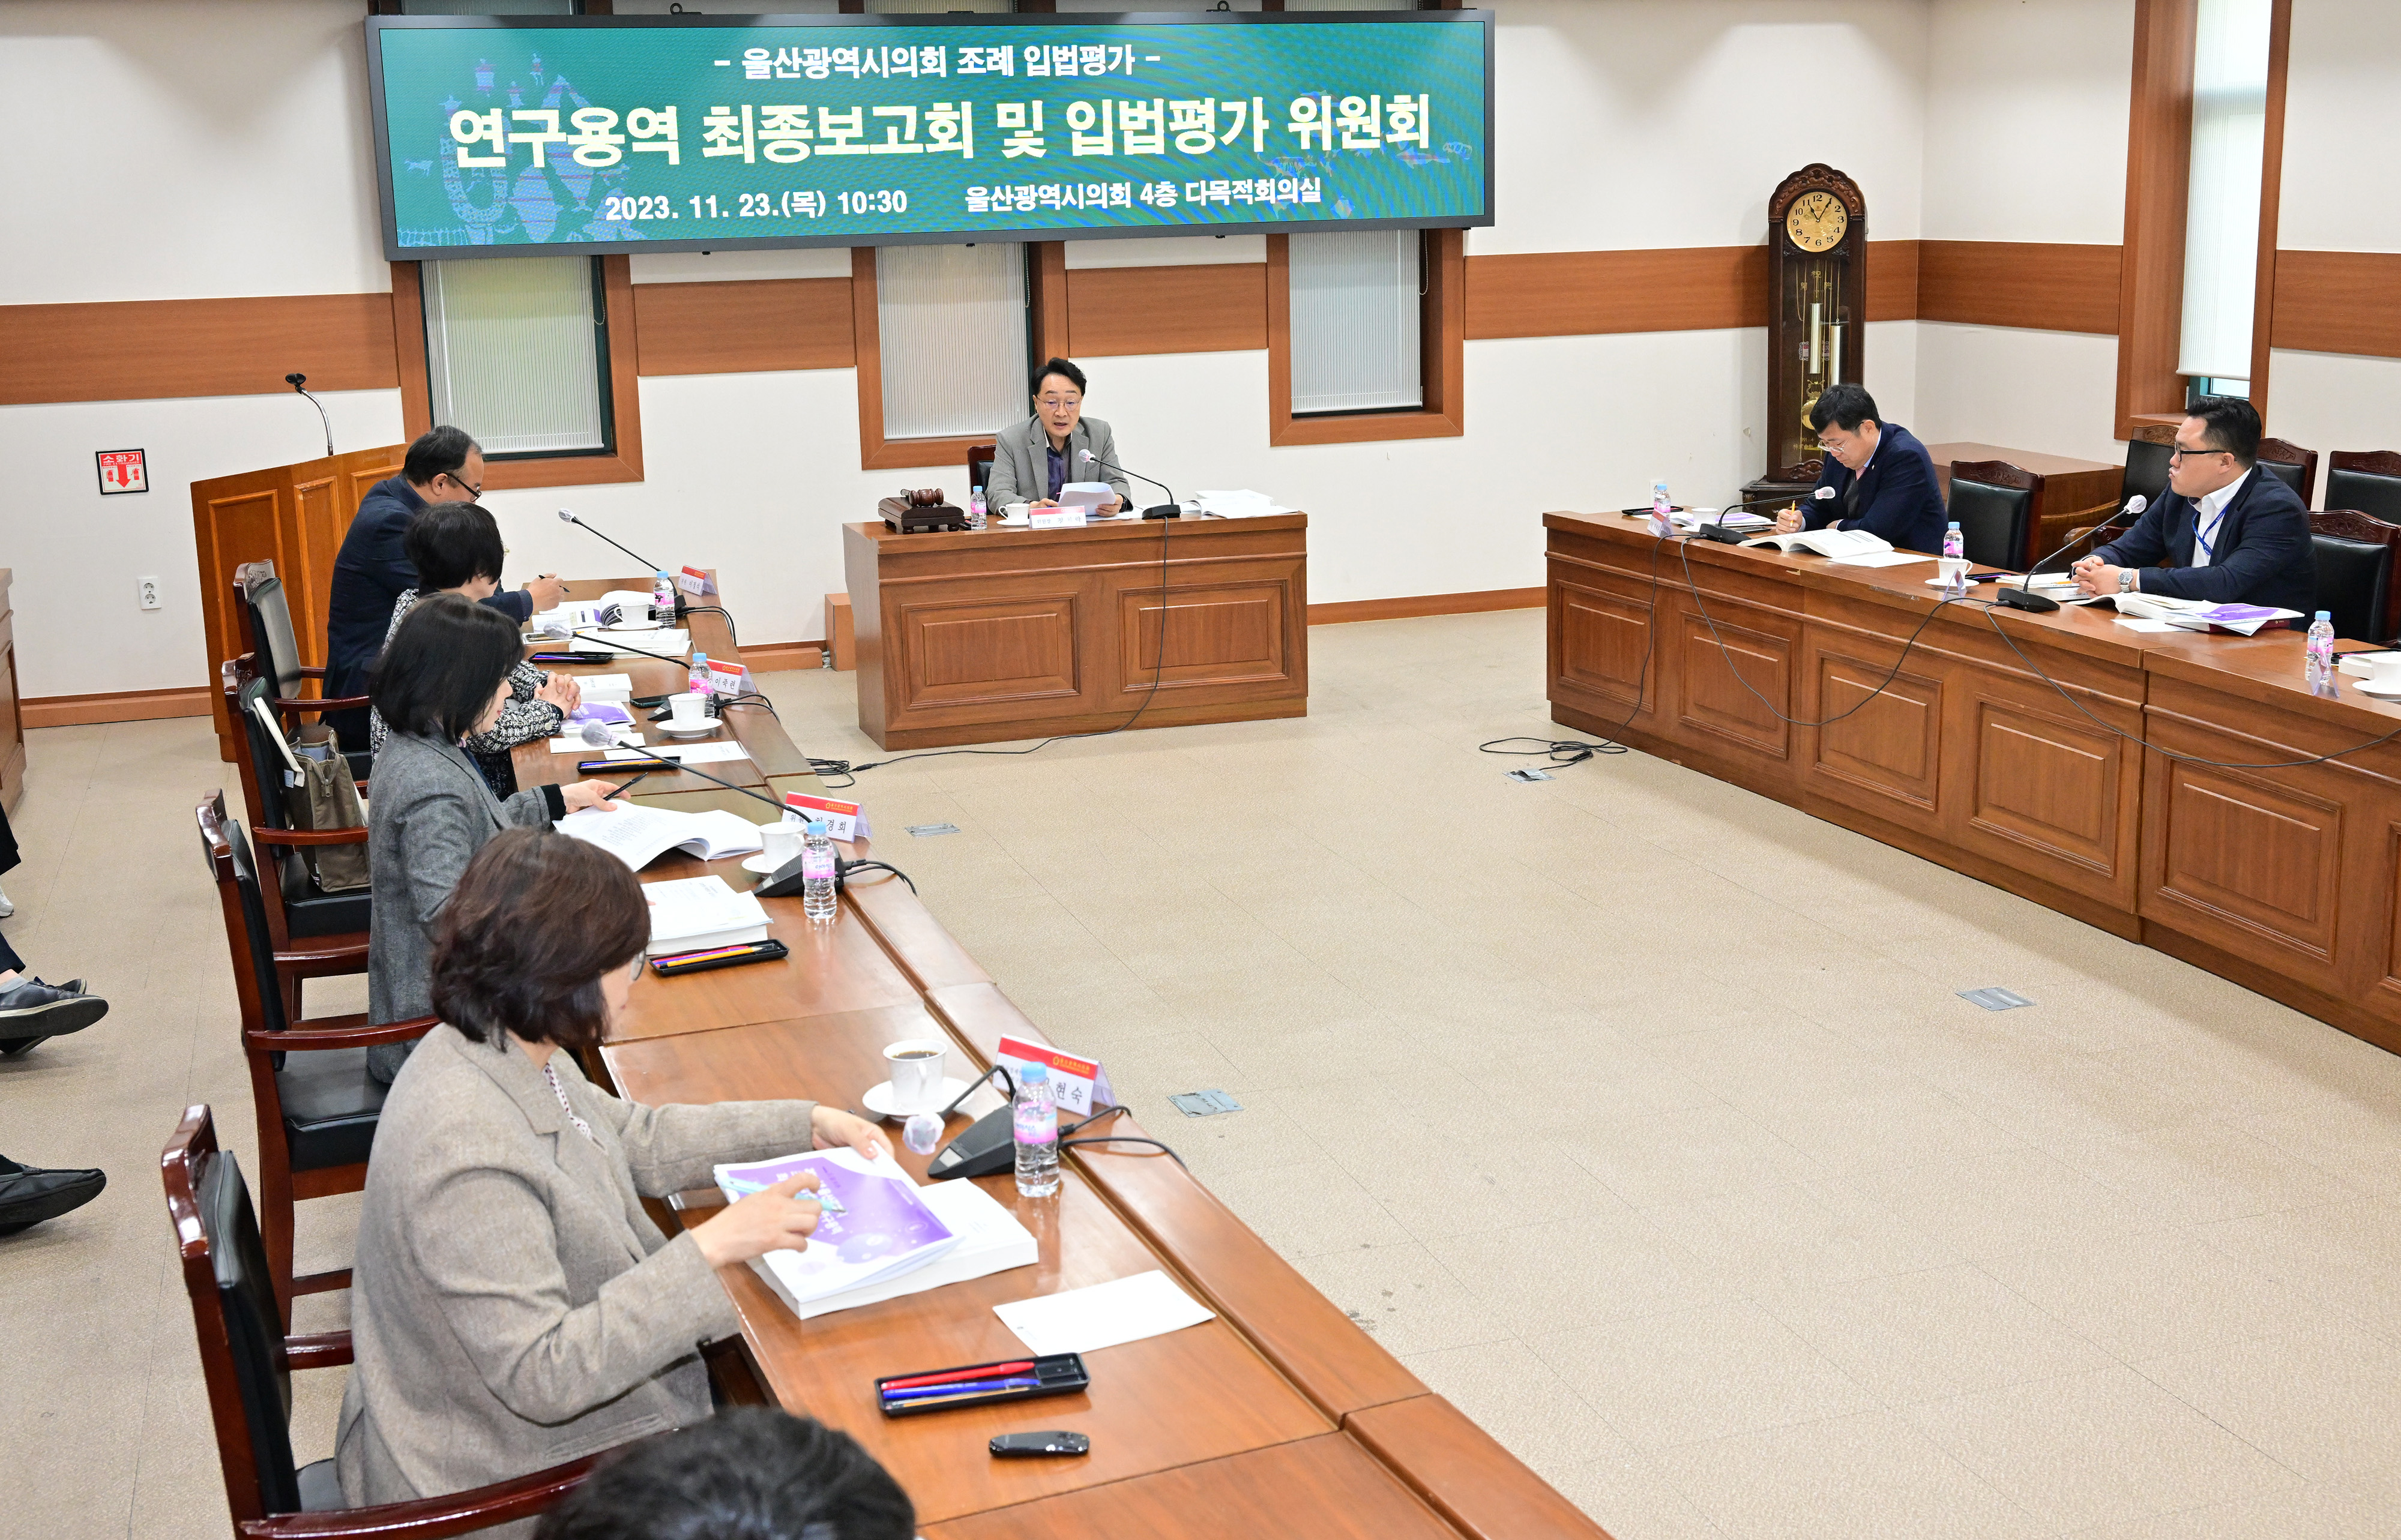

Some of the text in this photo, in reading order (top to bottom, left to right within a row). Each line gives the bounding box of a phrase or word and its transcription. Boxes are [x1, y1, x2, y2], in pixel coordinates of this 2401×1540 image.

[741, 46, 947, 79] 울산광역시의회
[957, 45, 1014, 77] 조례
[1023, 44, 1136, 77] 입법평가
[449, 93, 1430, 169] 연구용역 최종보고회 및 입법평가 위원회
[605, 189, 908, 221] 2023. 11. 23.(목) 10:30
[965, 176, 1322, 213] 울산광역시의회 4층 다목적회의실
[103, 454, 139, 463] 소화기
